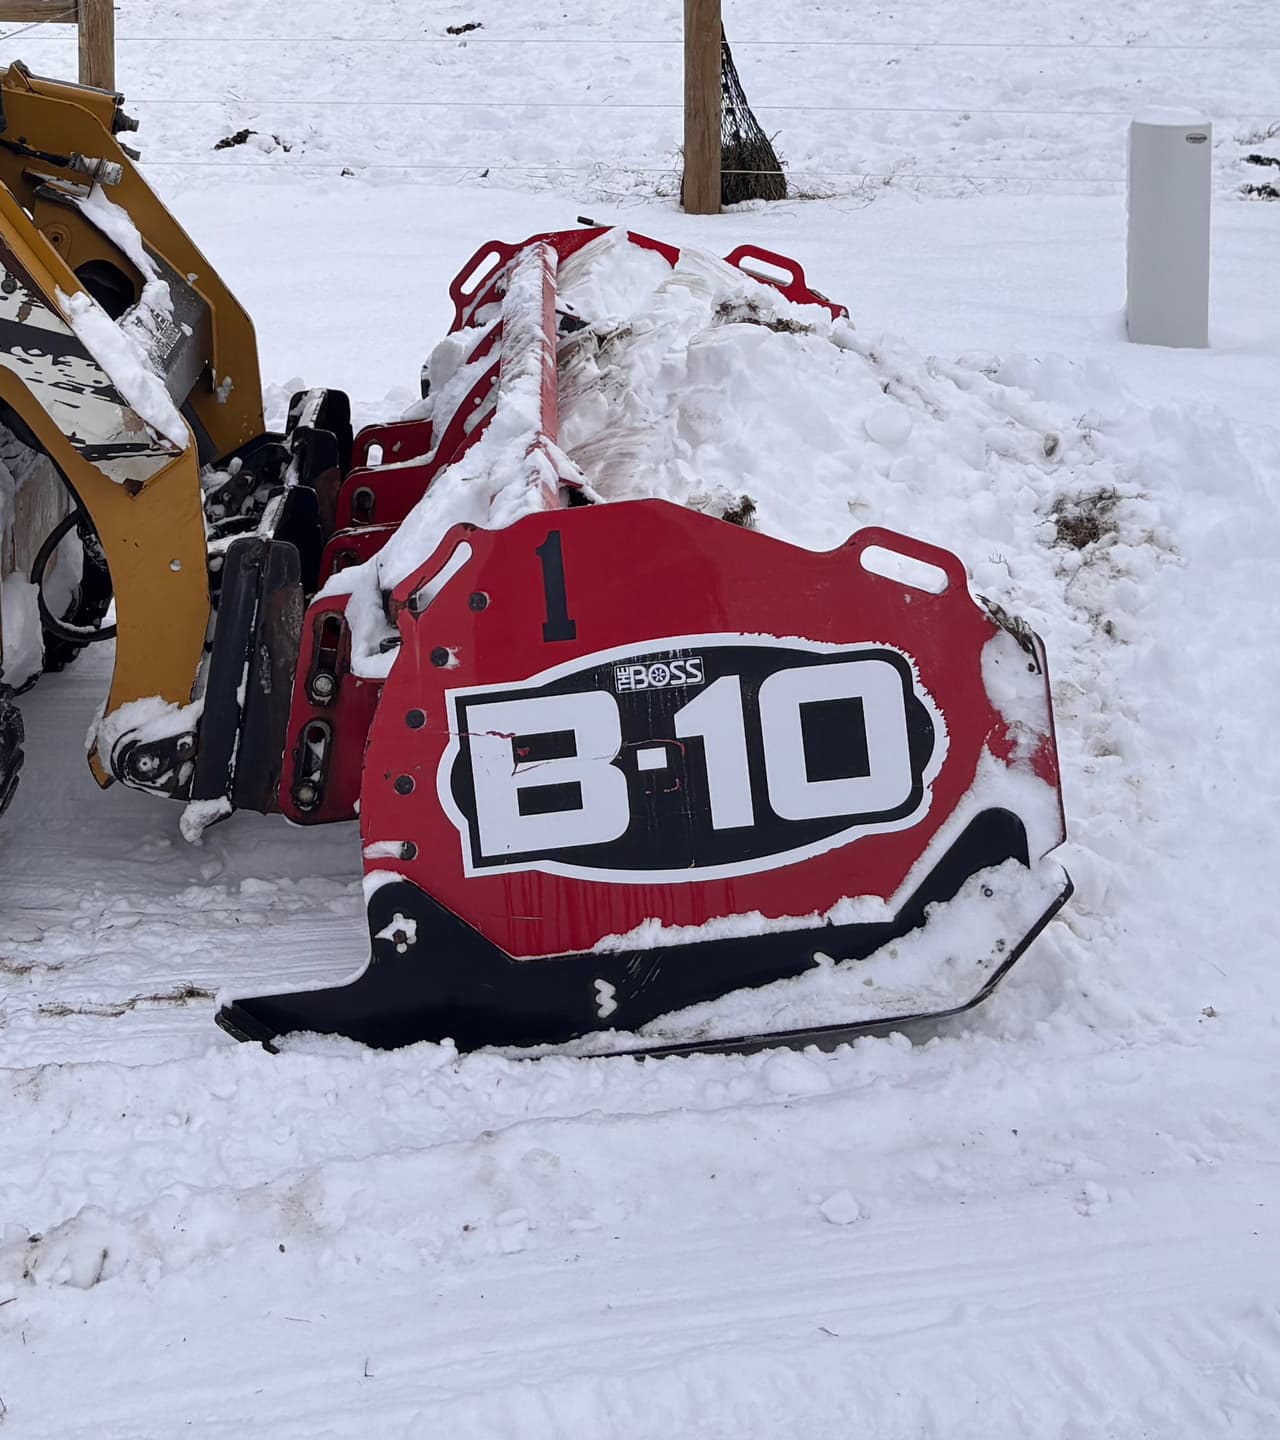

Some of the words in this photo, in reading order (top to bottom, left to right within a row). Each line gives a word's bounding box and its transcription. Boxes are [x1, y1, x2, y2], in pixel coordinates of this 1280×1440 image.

[535, 529, 577, 642] 1
[616, 666, 630, 691] THE
[629, 658, 702, 690] BOSS
[465, 659, 914, 858] B-10
